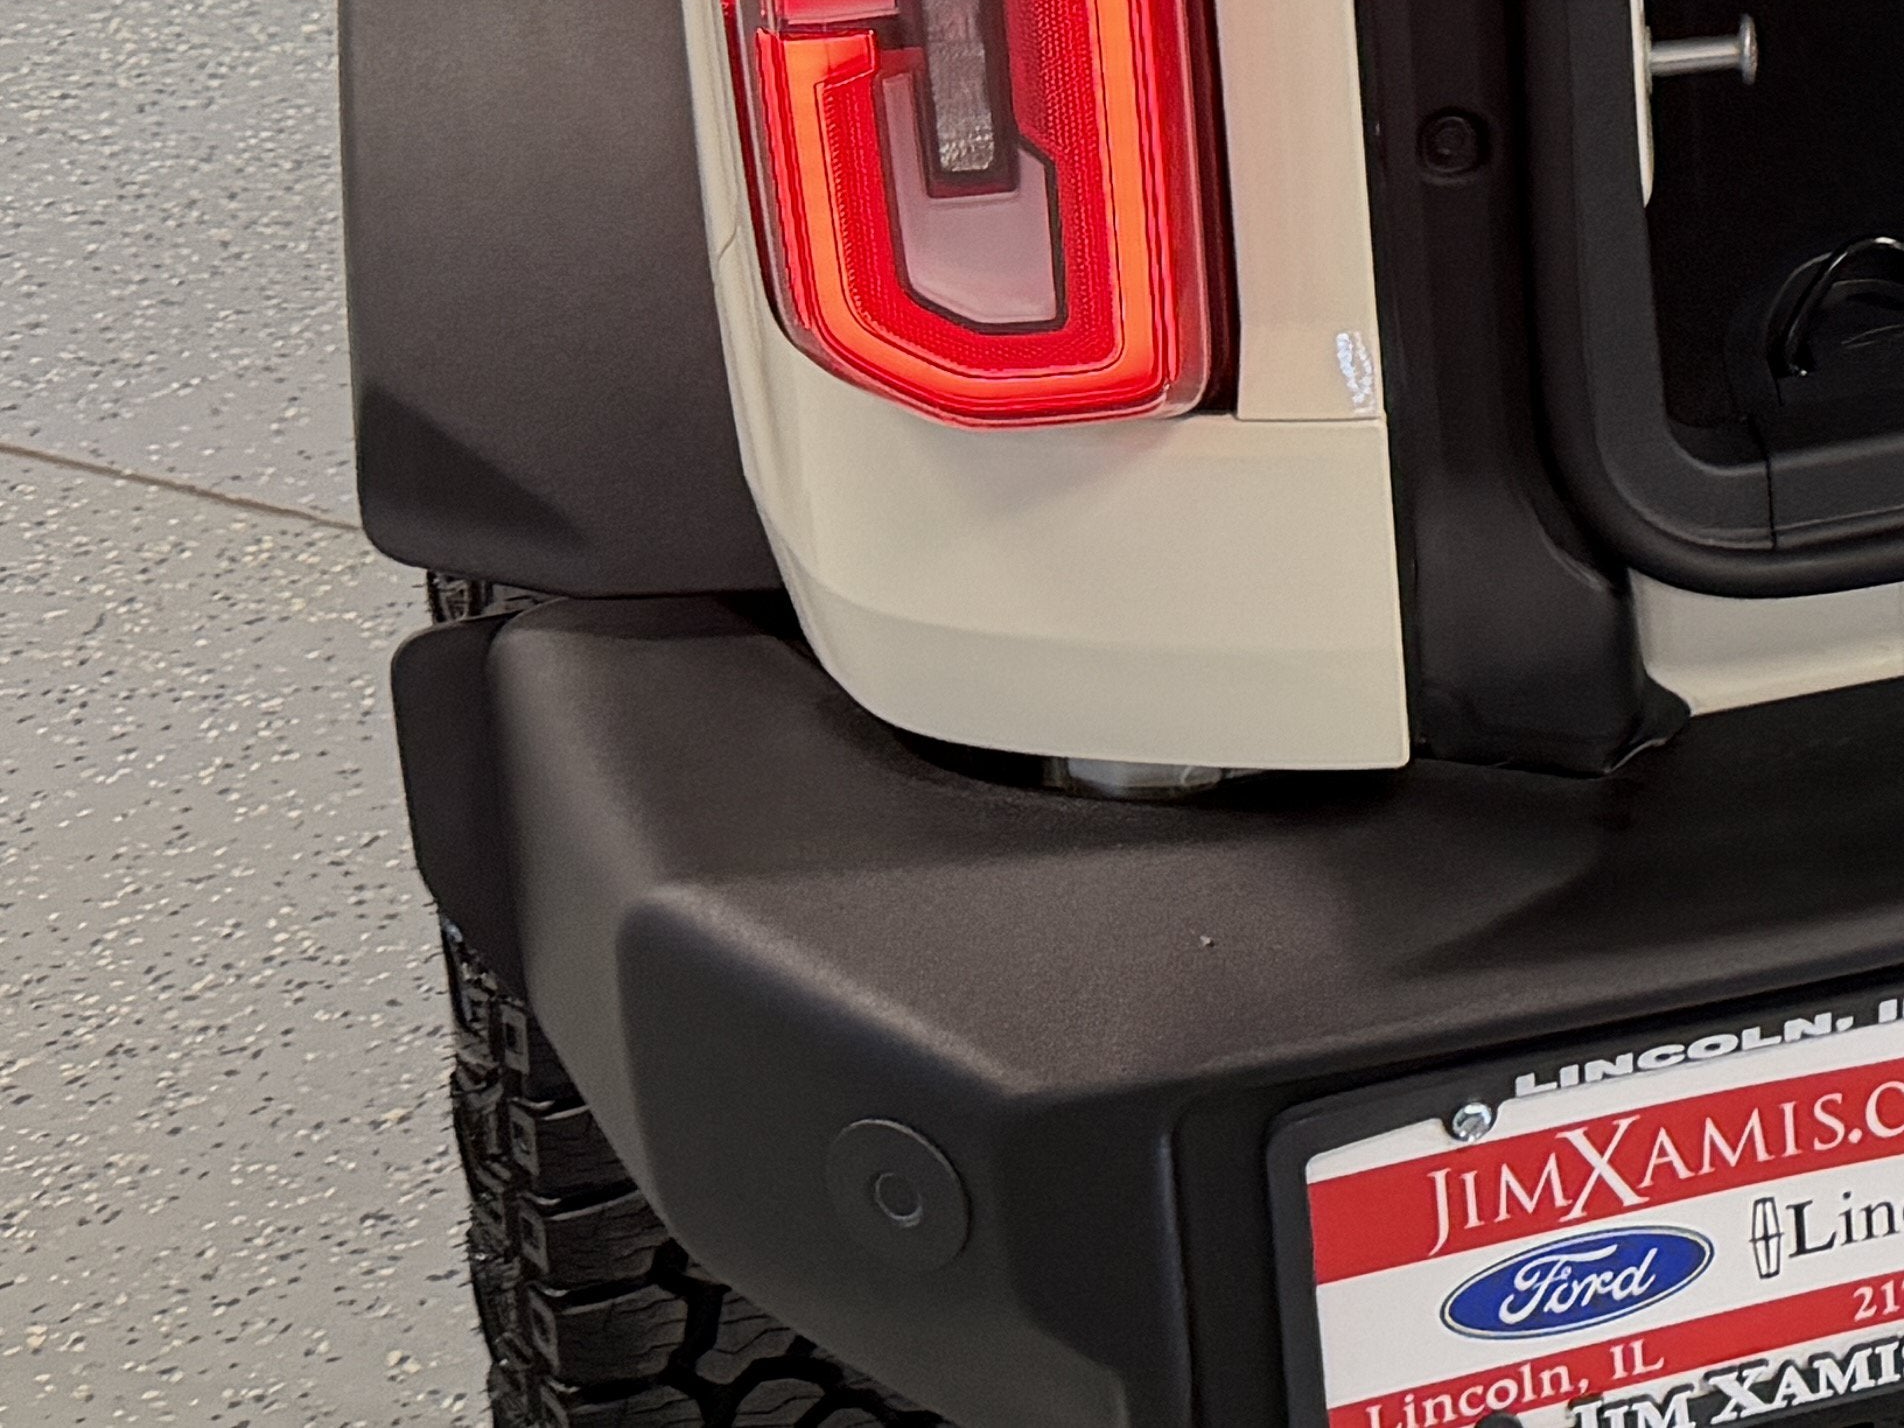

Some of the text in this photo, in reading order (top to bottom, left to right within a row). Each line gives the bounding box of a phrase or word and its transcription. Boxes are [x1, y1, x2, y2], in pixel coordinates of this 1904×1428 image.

[1515, 1012, 1854, 1098] LINCOLN,
[1498, 1243, 1660, 1325] Ford
[1365, 1338, 1665, 1428] Lincoln, IL
